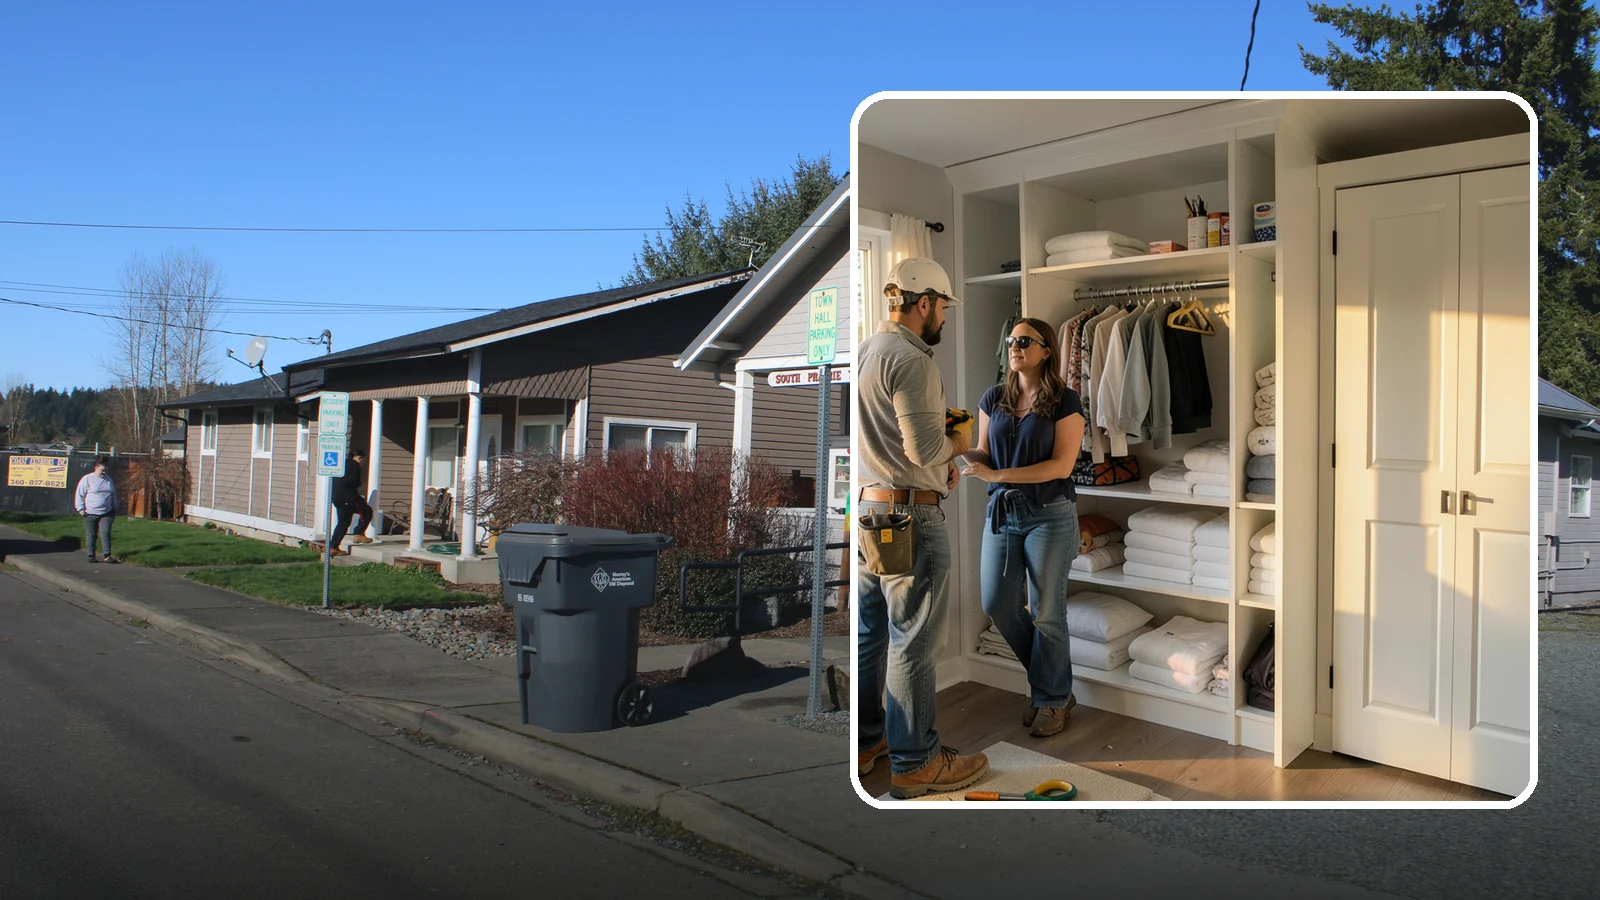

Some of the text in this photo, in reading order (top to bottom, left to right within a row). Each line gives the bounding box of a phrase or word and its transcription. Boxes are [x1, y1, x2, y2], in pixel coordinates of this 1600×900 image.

[814, 294, 833, 308] TOWN
[814, 311, 832, 324] HALL
[810, 327, 836, 341] PARKING
[813, 344, 831, 357] ONLY
[775, 373, 801, 384] SOUTH
[808, 371, 842, 383] PRIE
